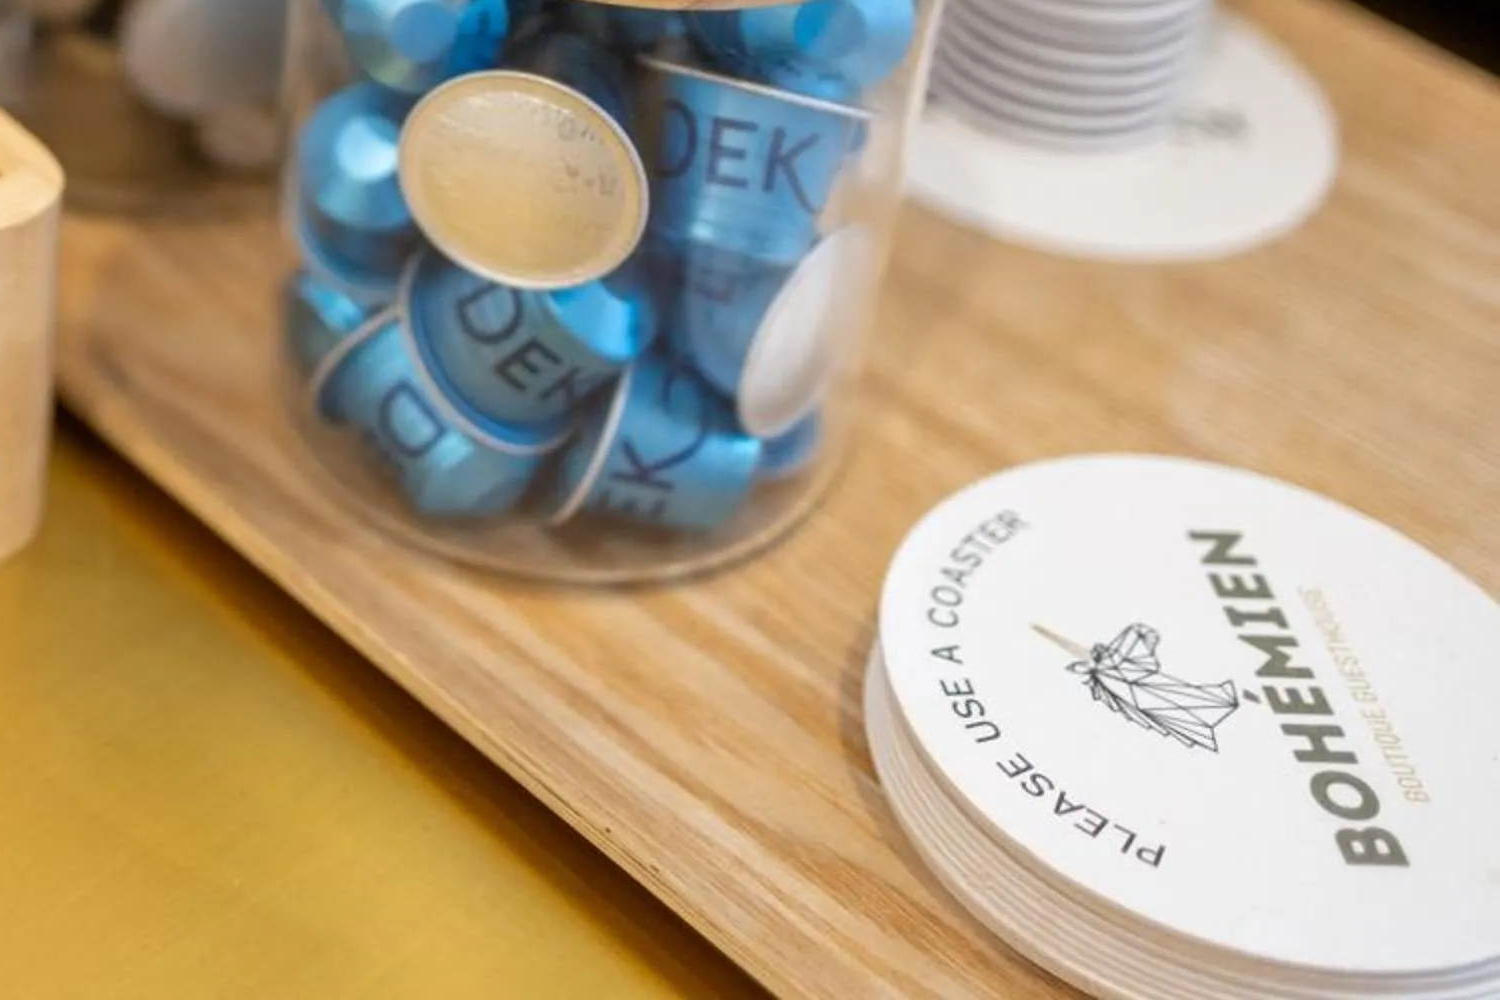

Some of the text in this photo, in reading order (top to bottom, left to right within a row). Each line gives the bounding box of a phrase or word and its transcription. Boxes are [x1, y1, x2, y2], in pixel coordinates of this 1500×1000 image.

[656, 100, 822, 214] DEK
[926, 508, 1166, 868] PLEASE USE A COASTER
[1186, 529, 1410, 868] BOHÉMIEN
